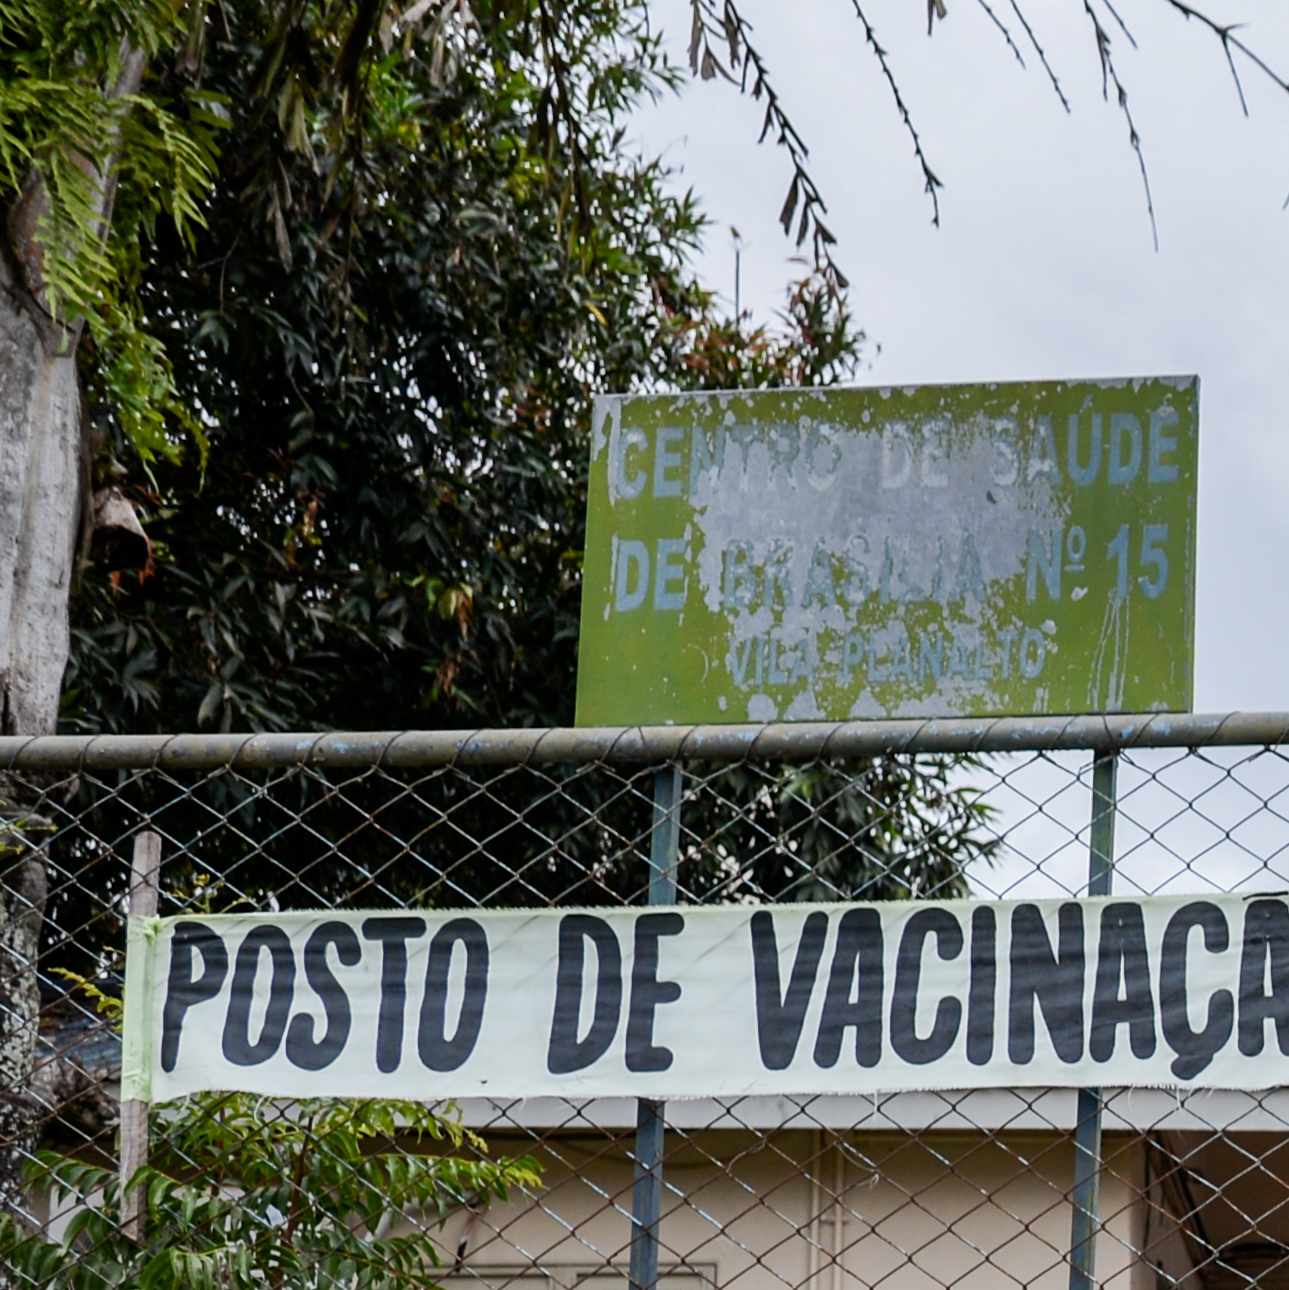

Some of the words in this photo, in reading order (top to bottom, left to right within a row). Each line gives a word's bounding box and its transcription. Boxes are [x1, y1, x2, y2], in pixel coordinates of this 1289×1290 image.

[617, 419, 843, 500] CENTRO
[880, 415, 951, 490] DE
[989, 394, 1181, 487] SAÚDE
[614, 538, 687, 613] DE
[1026, 525, 1087, 601] Nº
[1106, 525, 1170, 600] 15
[728, 634, 816, 687] VILA
[842, 628, 1047, 684] PLANALTO
[161, 917, 490, 1074] POSTO
[547, 911, 686, 1075] DE
